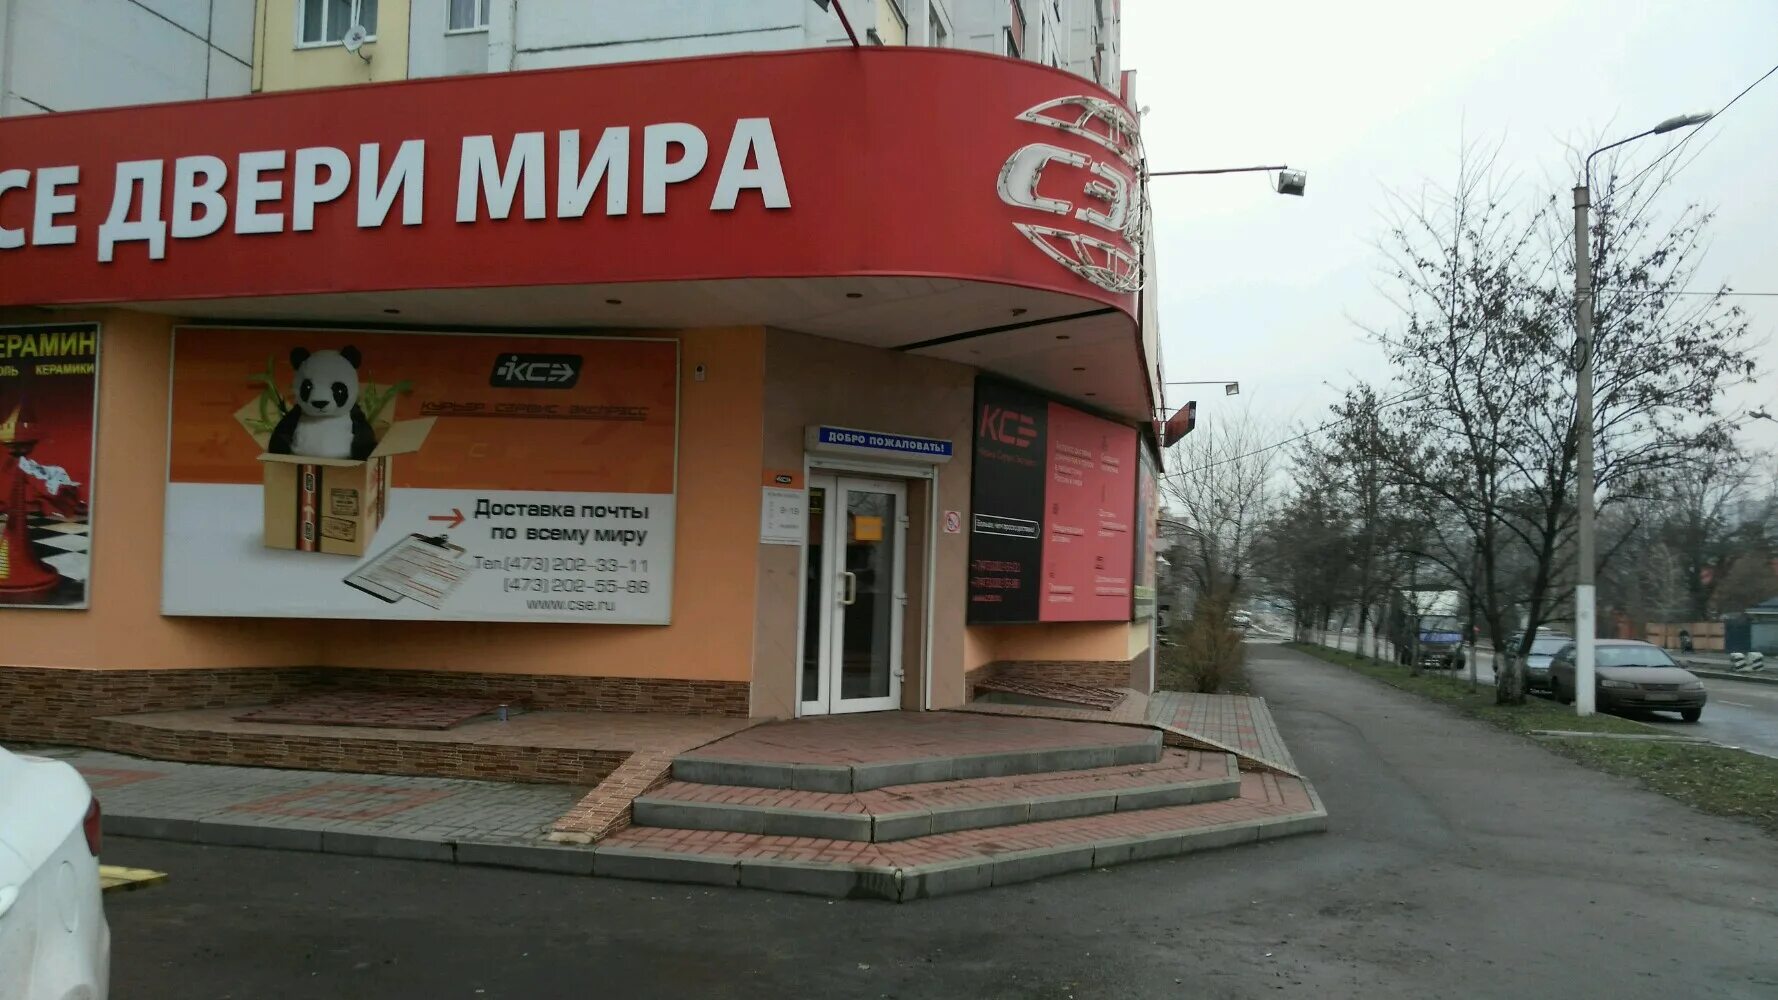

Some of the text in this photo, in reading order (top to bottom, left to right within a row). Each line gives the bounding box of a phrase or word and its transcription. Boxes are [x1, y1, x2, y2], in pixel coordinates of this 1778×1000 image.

[0, 117, 793, 263] СЕ ДВЕРИ МИРА
[35, 361, 95, 376] КЕРАМИКИ
[828, 431, 945, 453] ДОБРО ПОЖАЛОВАТЬ!
[473, 498, 650, 519] Доставка почты
[491, 526, 649, 547] по всему миру
[526, 599, 617, 612] www.cse.ru
